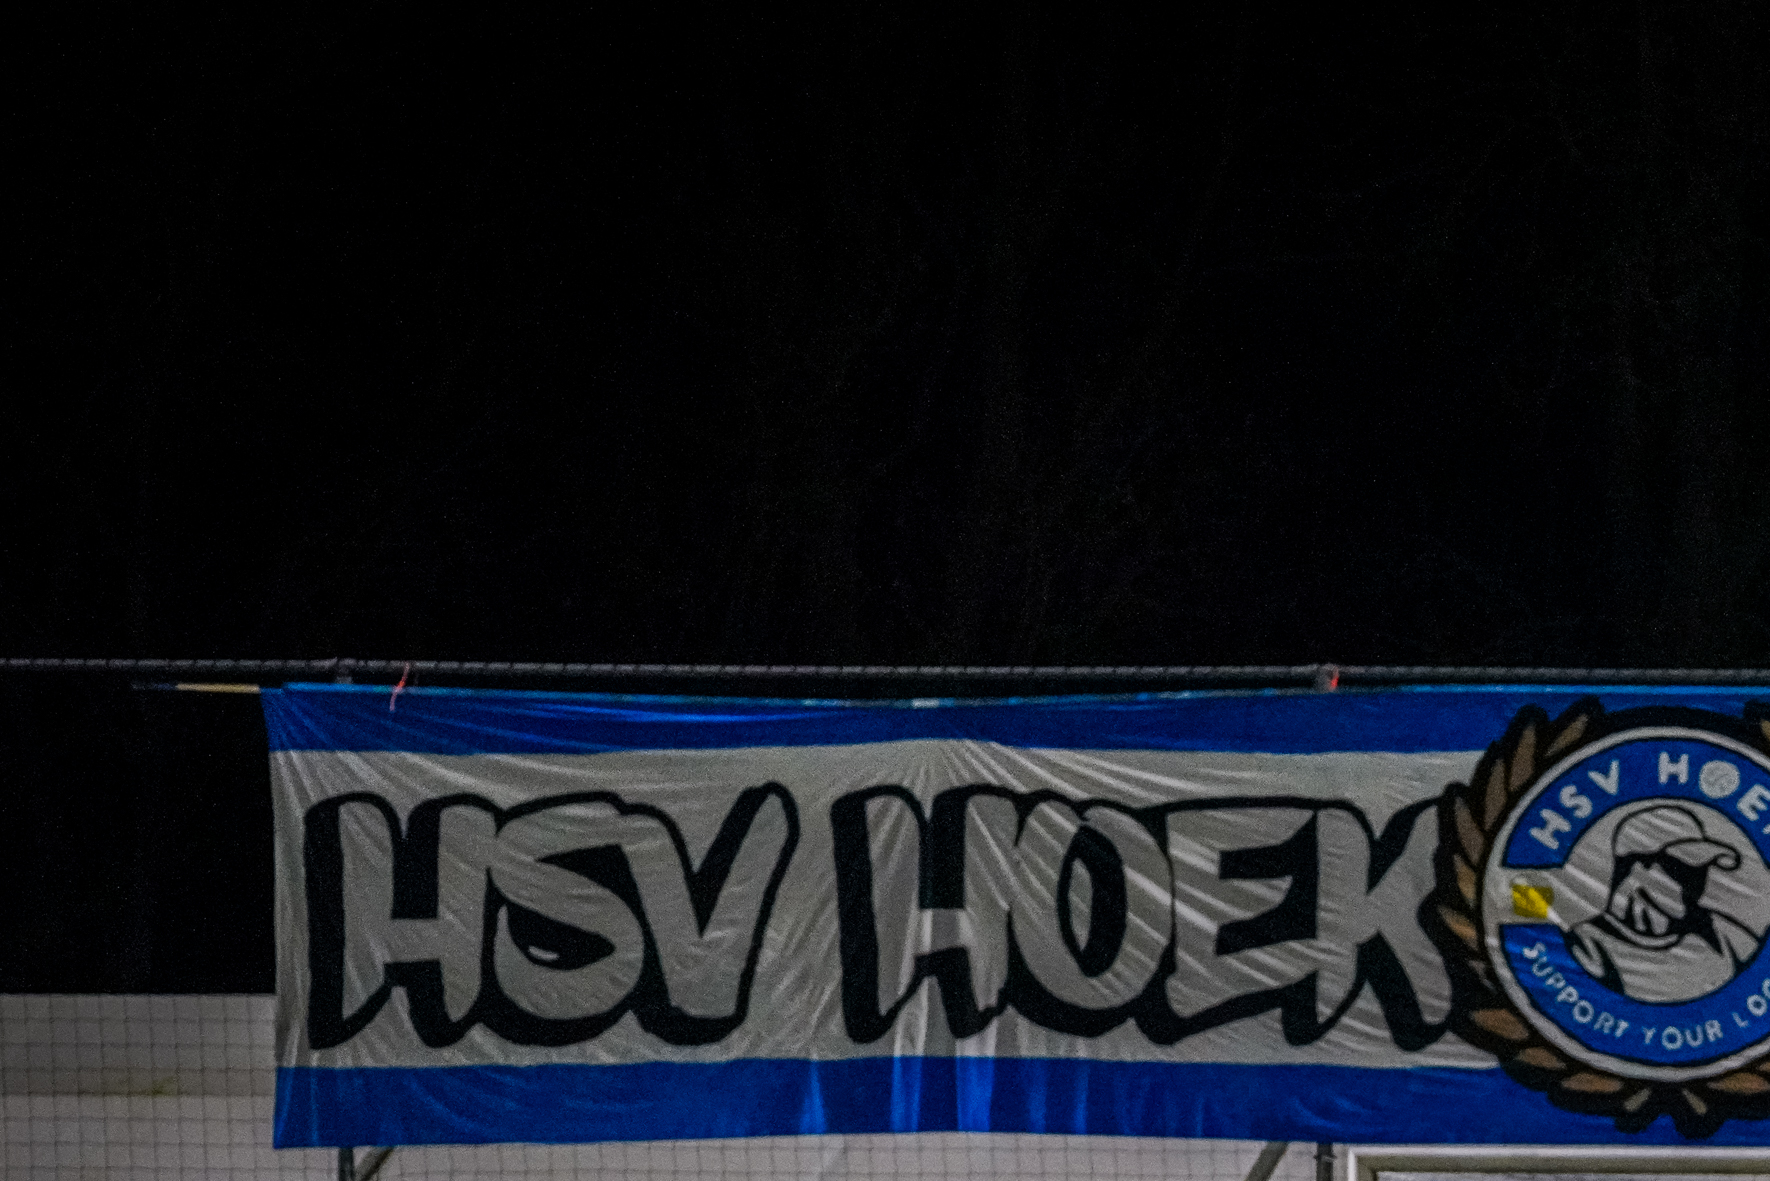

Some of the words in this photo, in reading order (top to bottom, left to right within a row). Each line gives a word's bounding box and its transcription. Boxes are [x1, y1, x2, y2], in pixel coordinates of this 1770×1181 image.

[1529, 759, 1620, 849] HSV
[301, 782, 799, 1049] HSV
[831, 785, 1453, 1052] HOEK
[1522, 942, 1630, 1038] SUPPORT
[1641, 1018, 1723, 1051] YOUR
